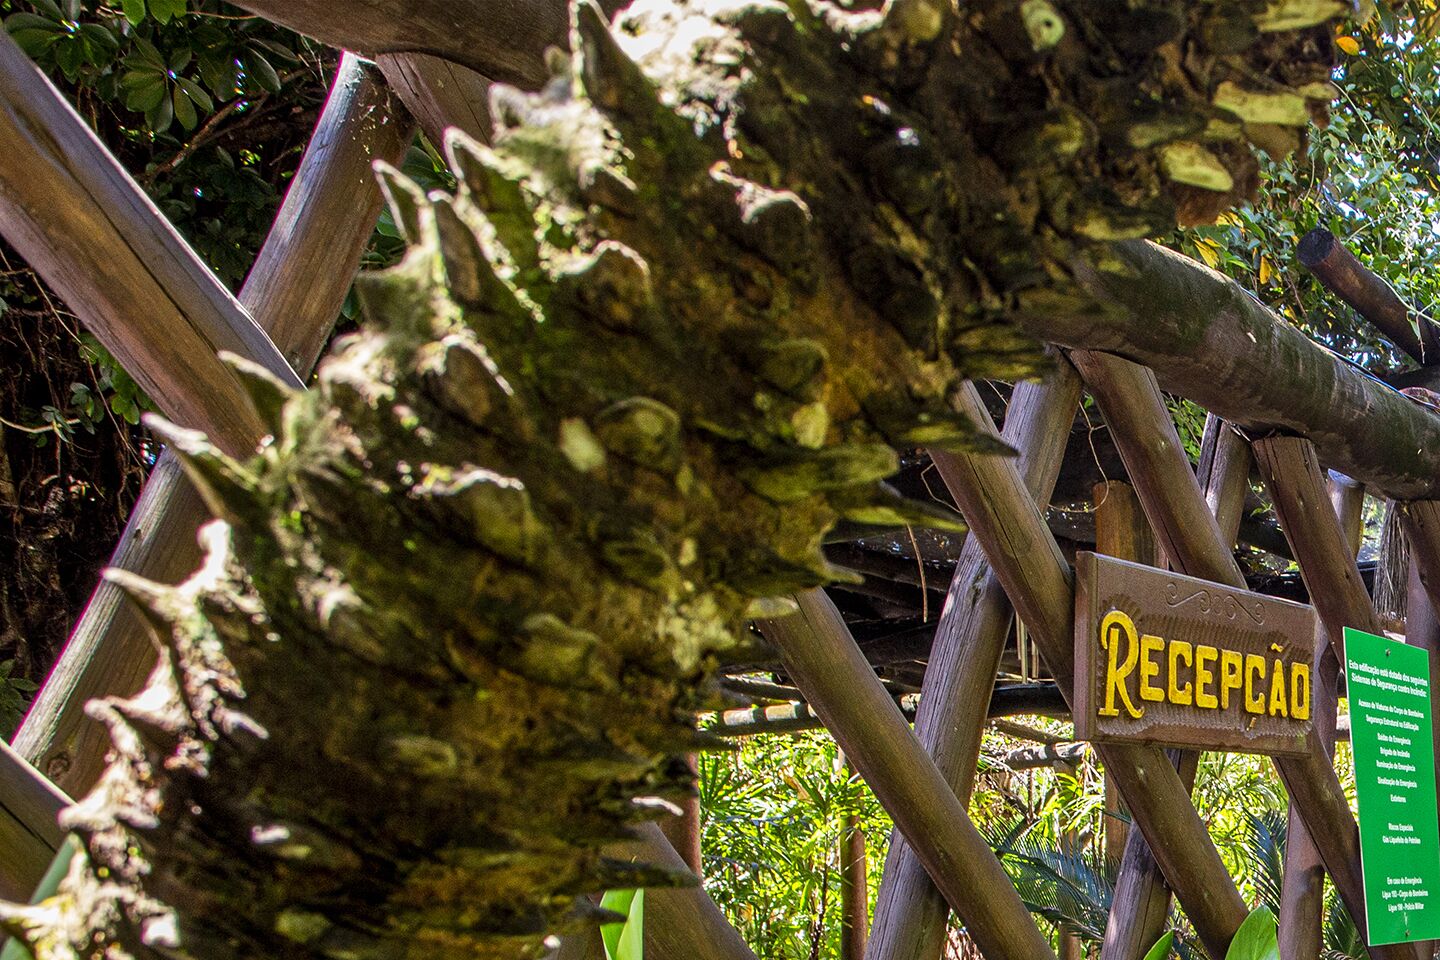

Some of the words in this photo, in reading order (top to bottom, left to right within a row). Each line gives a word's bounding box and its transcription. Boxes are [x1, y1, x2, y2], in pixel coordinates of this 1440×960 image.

[1098, 610, 1310, 731] RECEPÇÃO
[1349, 659, 1358, 670] Esta
[1359, 663, 1379, 675] edificação
[1352, 672, 1370, 684] Sistemas
[1371, 678, 1376, 686] de
[1377, 679, 1397, 692] Segurança
